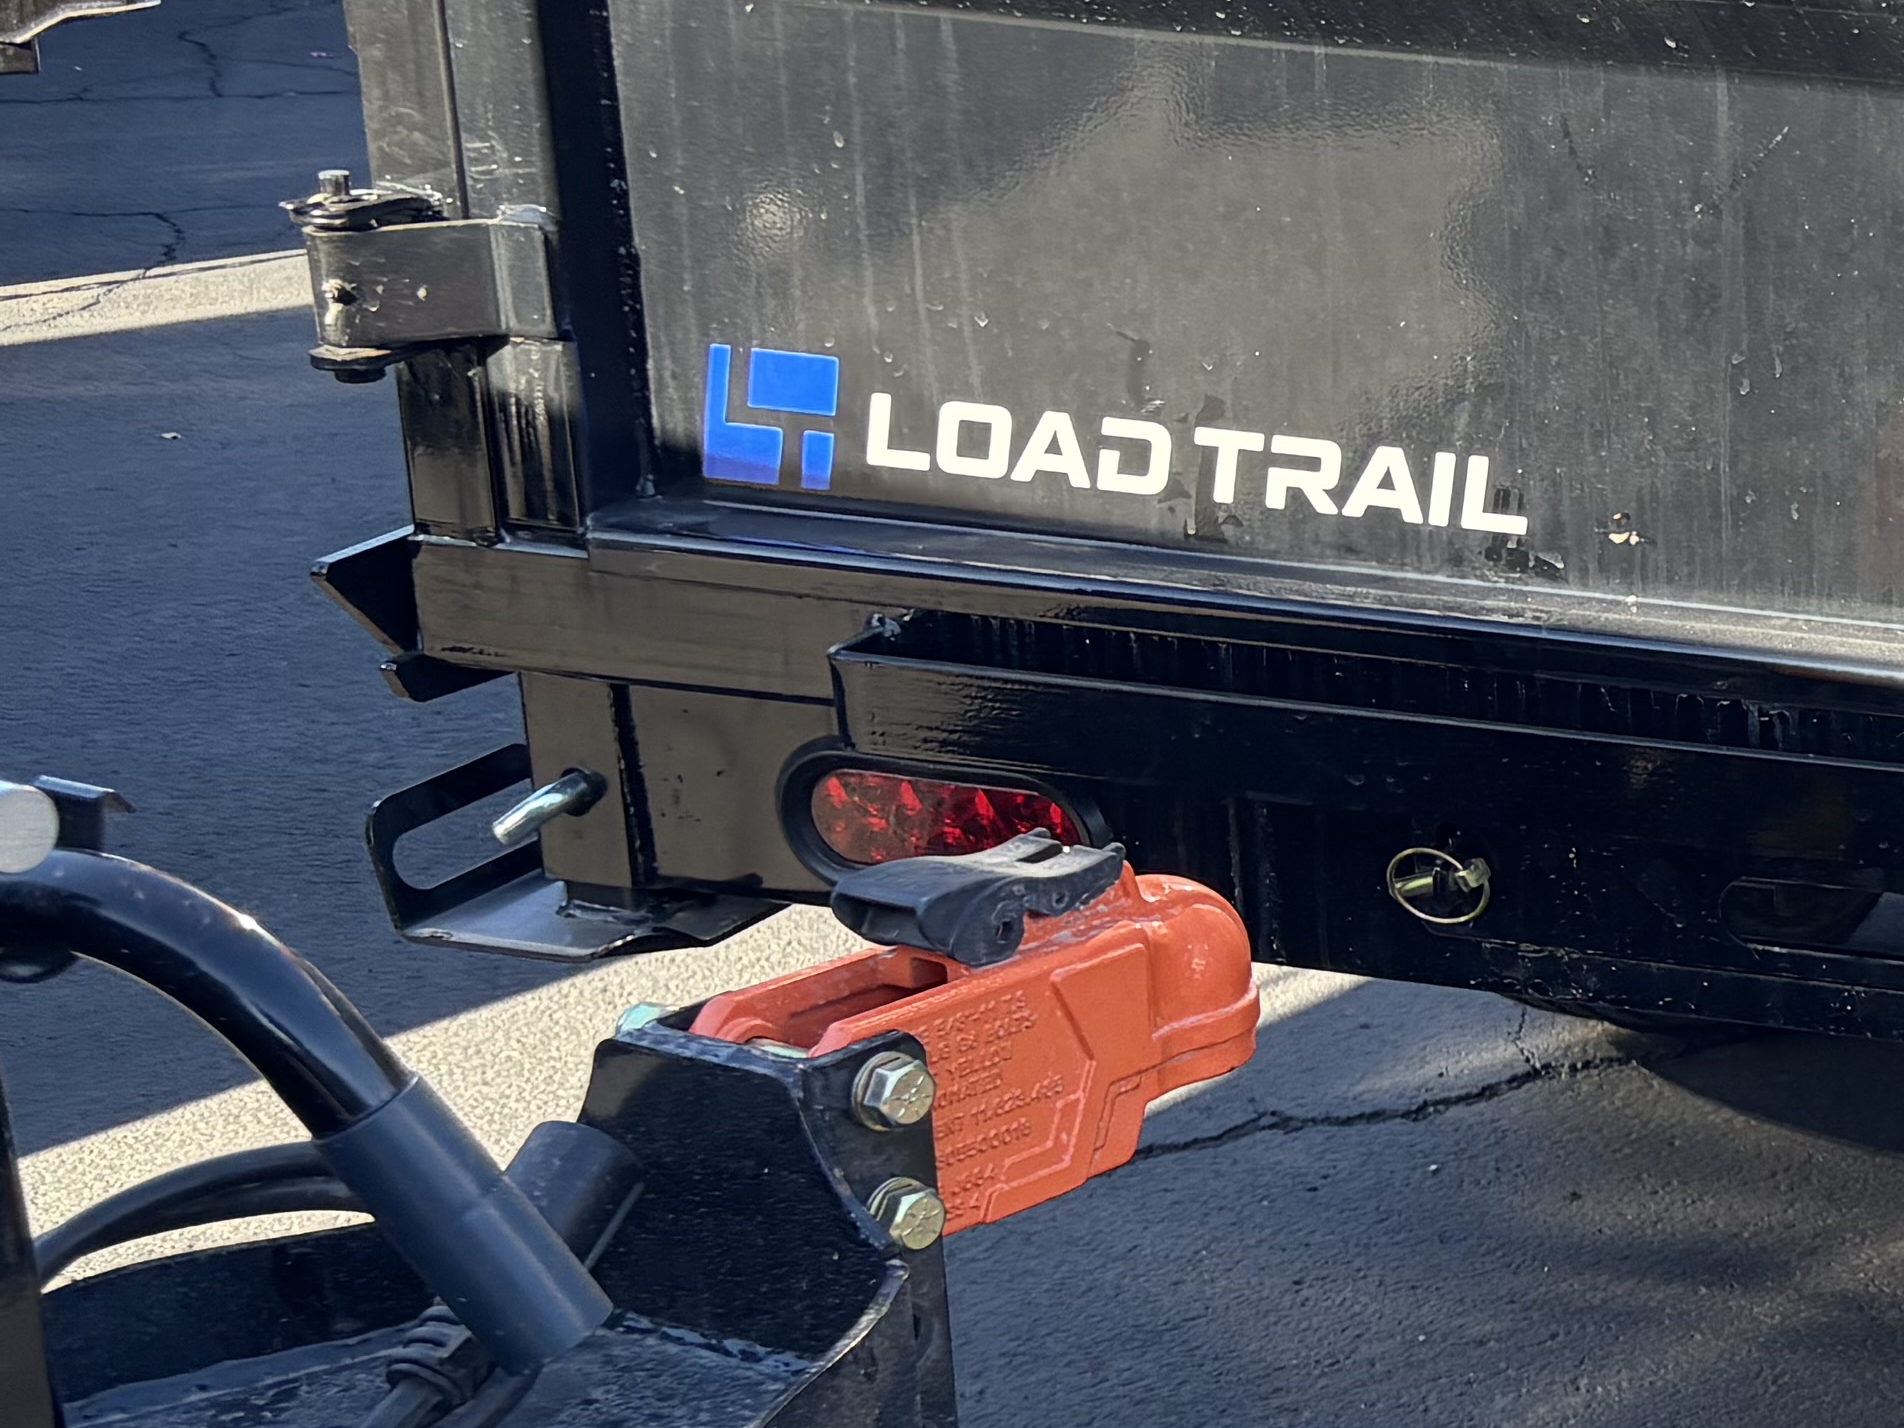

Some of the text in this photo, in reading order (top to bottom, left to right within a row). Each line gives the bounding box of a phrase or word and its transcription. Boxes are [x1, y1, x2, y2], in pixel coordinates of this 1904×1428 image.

[866, 391, 1174, 497] LOAD
[1193, 426, 1528, 536] TRAIL
[945, 1039, 1014, 1079] YELLOW
